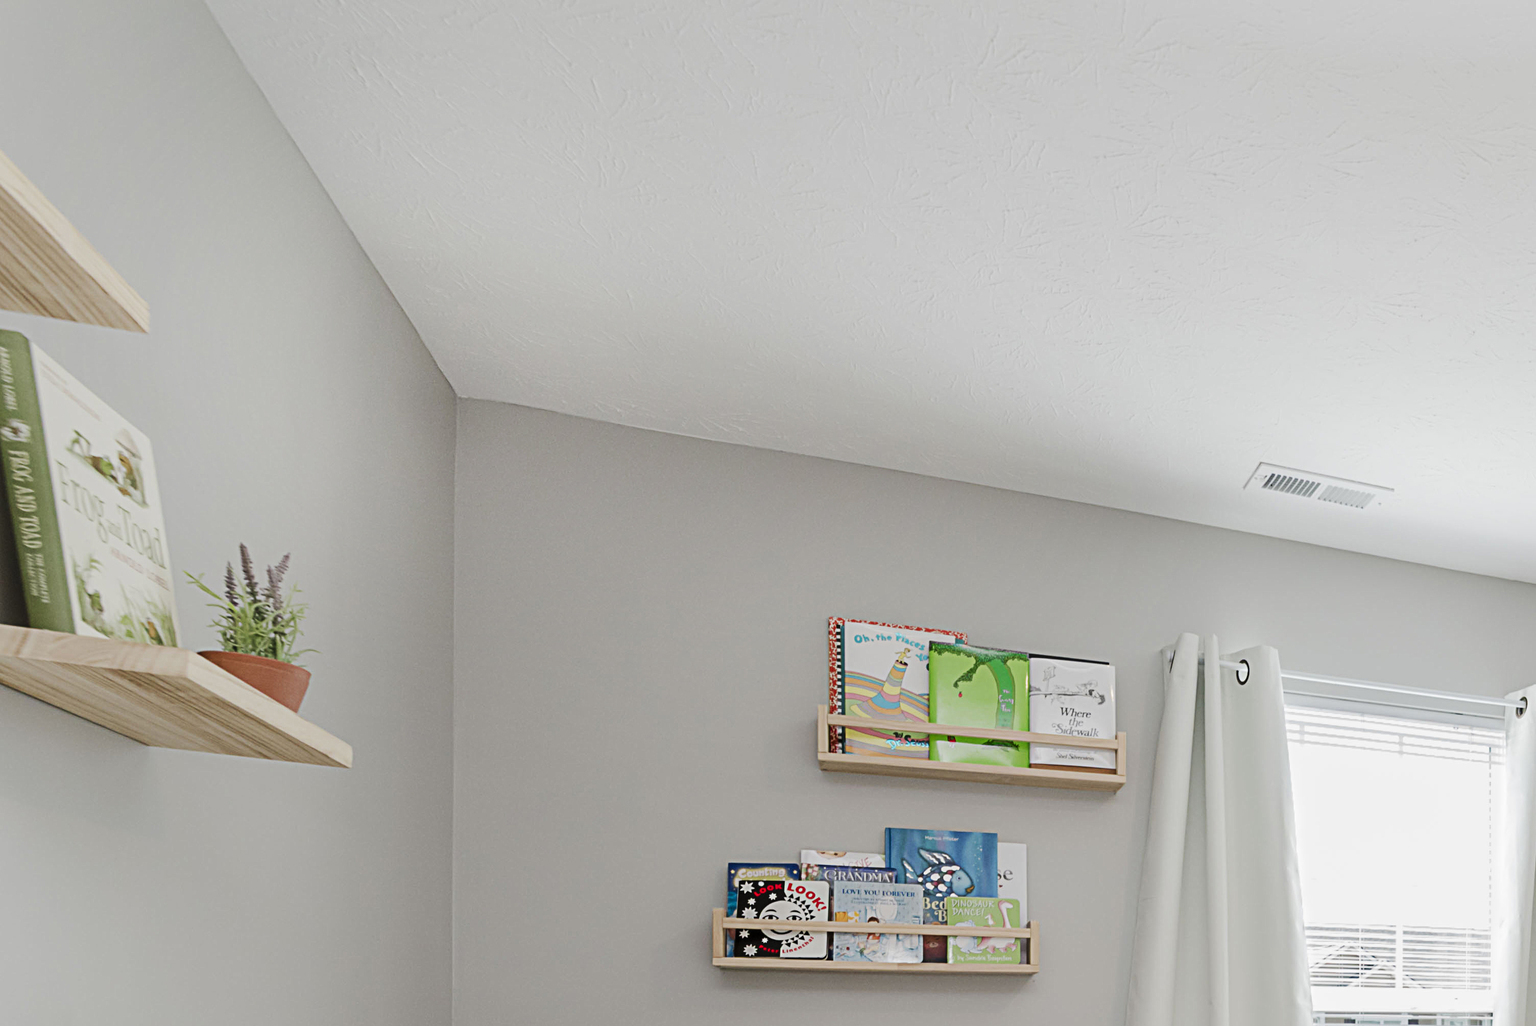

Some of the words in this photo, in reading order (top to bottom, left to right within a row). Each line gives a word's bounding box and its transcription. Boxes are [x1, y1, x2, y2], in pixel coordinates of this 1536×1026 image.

[8, 450, 34, 483] FROG
[14, 485, 37, 513] AND
[55, 459, 108, 544] Frog
[117, 504, 167, 570] Toad
[19, 515, 43, 549] TOAD
[854, 634, 875, 644] Oh,
[876, 633, 892, 642] the
[895, 632, 925, 651] Places
[1060, 706, 1092, 718] Where
[1068, 717, 1084, 727] the
[1051, 722, 1099, 738] Sidewalk
[738, 868, 786, 878] Counting
[824, 869, 892, 882] GRANDMA
[753, 883, 782, 897] LOOK
[786, 882, 827, 912] LOOK!
[882, 890, 915, 898] FOREVER
[951, 899, 995, 908] DINOSAUR
[952, 907, 985, 916] DANCE!
[758, 944, 779, 953] Peter
